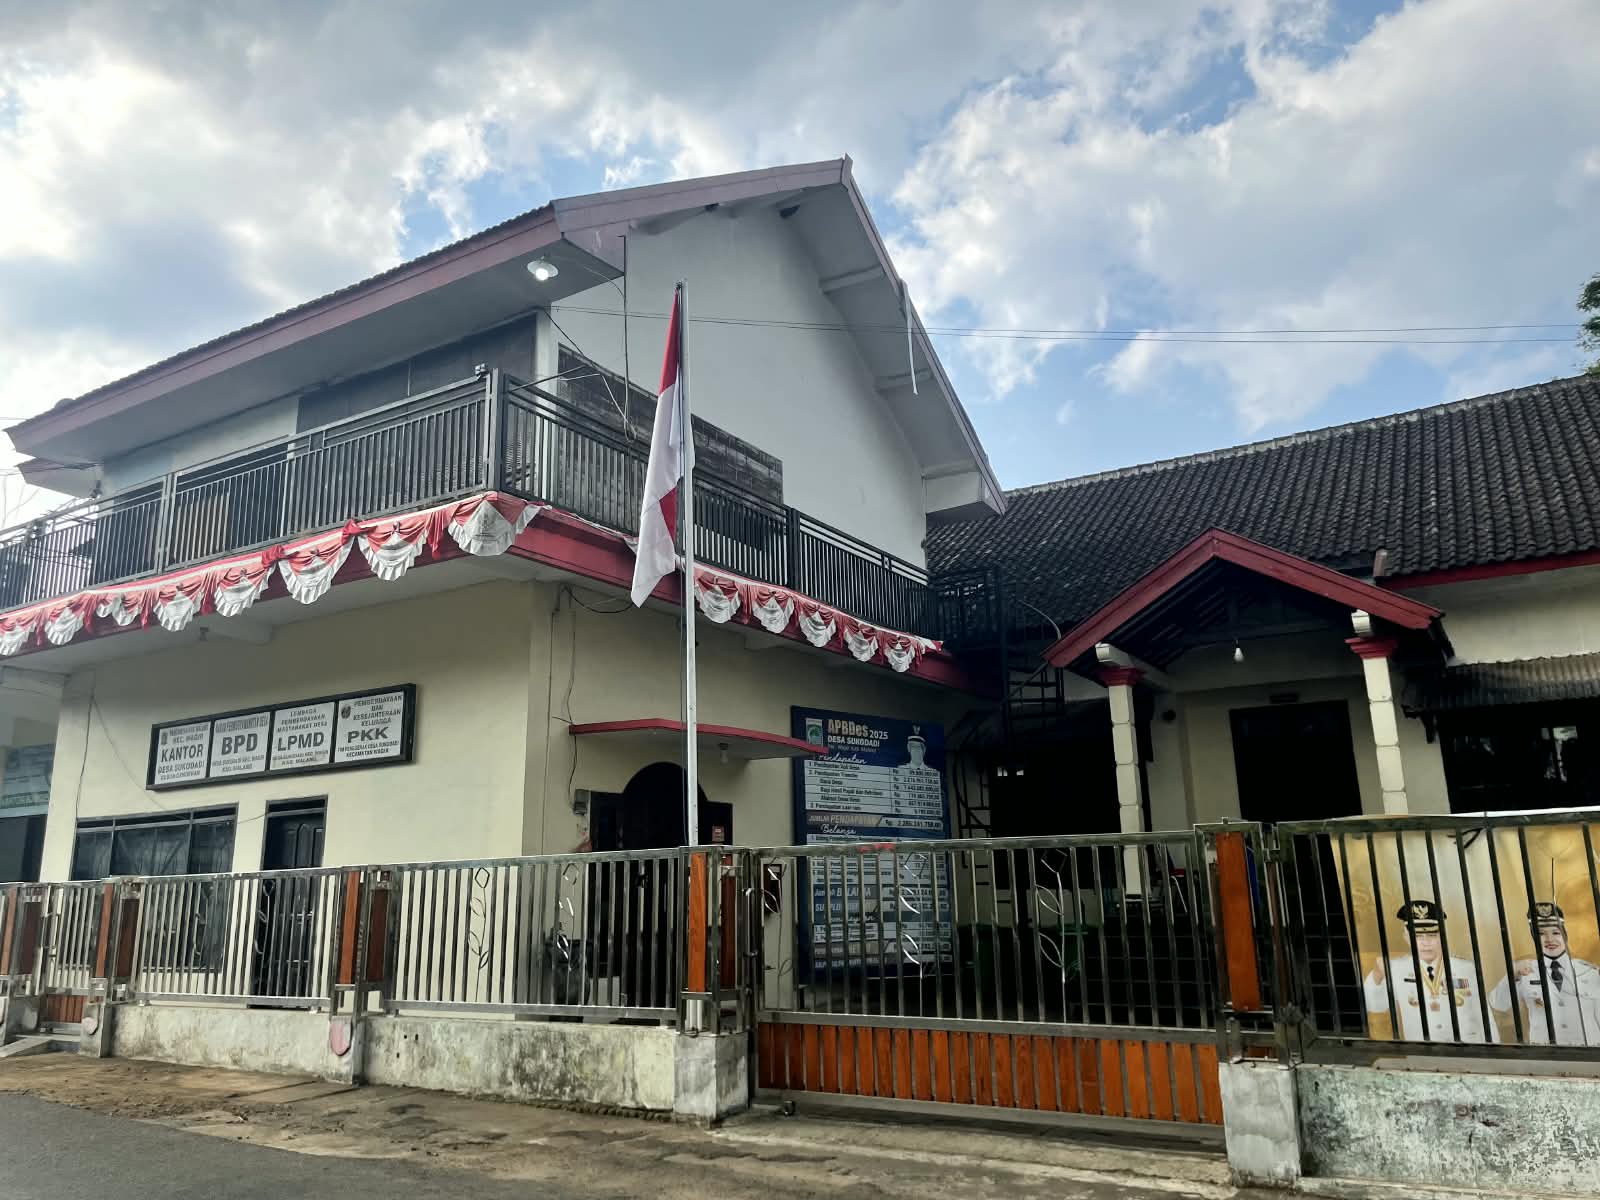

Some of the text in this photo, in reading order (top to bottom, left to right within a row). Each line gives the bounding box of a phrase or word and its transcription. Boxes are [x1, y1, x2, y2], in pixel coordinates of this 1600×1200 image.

[352, 710, 401, 720] KESEJAHTERAAN
[278, 732, 325, 752] LPMD
[347, 726, 389, 744] PKK
[828, 736, 845, 744] DESA
[847, 737, 880, 748] SUKODADI
[869, 730, 888, 740] 2025
[221, 733, 258, 756] BPD
[161, 744, 204, 762] KANTOR
[158, 760, 204, 774] DESA SUKODADI
